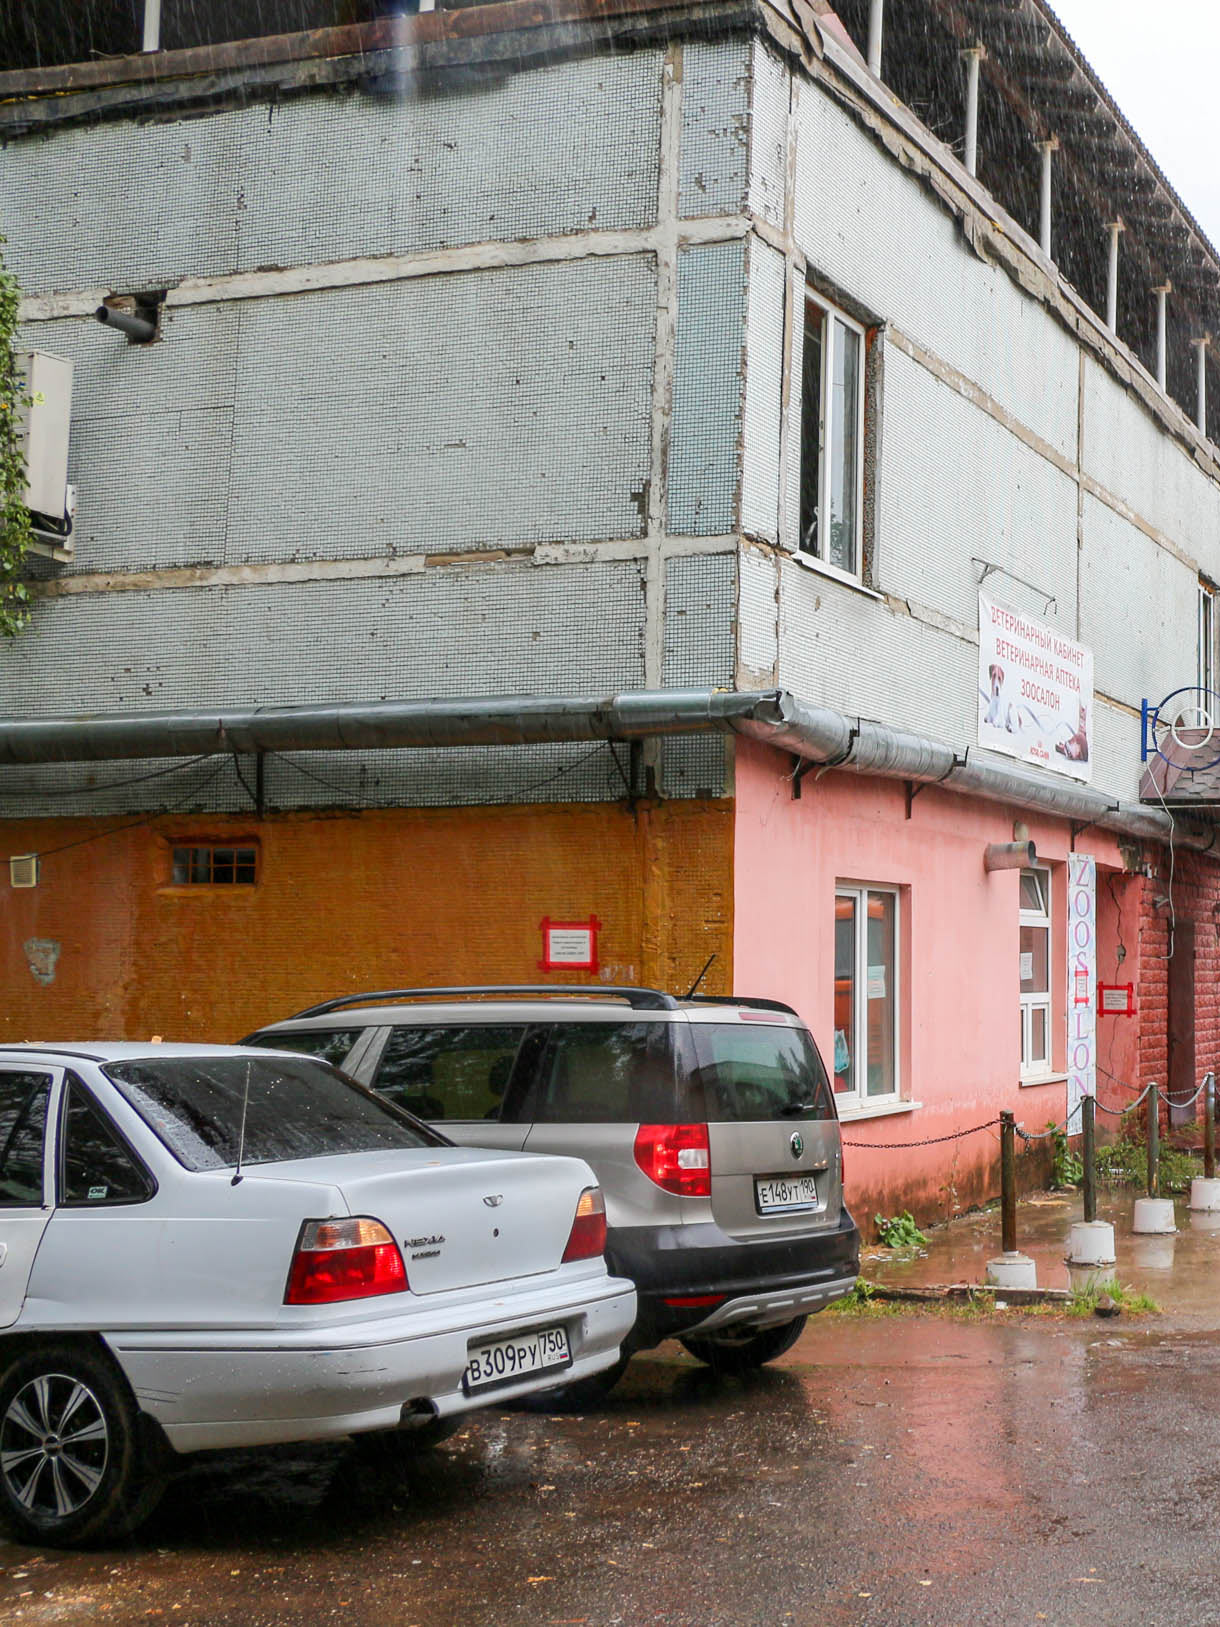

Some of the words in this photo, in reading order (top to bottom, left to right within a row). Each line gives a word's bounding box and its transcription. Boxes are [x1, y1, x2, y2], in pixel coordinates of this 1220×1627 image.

[991, 606, 1052, 651] ВЕТЕРИНАРНЫЙ
[1053, 638, 1084, 669] КАБИНЕТ
[996, 637, 1054, 681] ВЕТЕРИНАРНАЯ
[1056, 667, 1081, 693] АПТЕКА
[1021, 678, 1061, 711] ЗООСАЛОН
[1073, 860, 1091, 1100] ZOOSLON
[761, 1182, 799, 1203] Е148УТ
[800, 1178, 814, 1194] 190
[469, 1344, 537, 1381] В309РУ
[539, 1330, 563, 1355] 750
